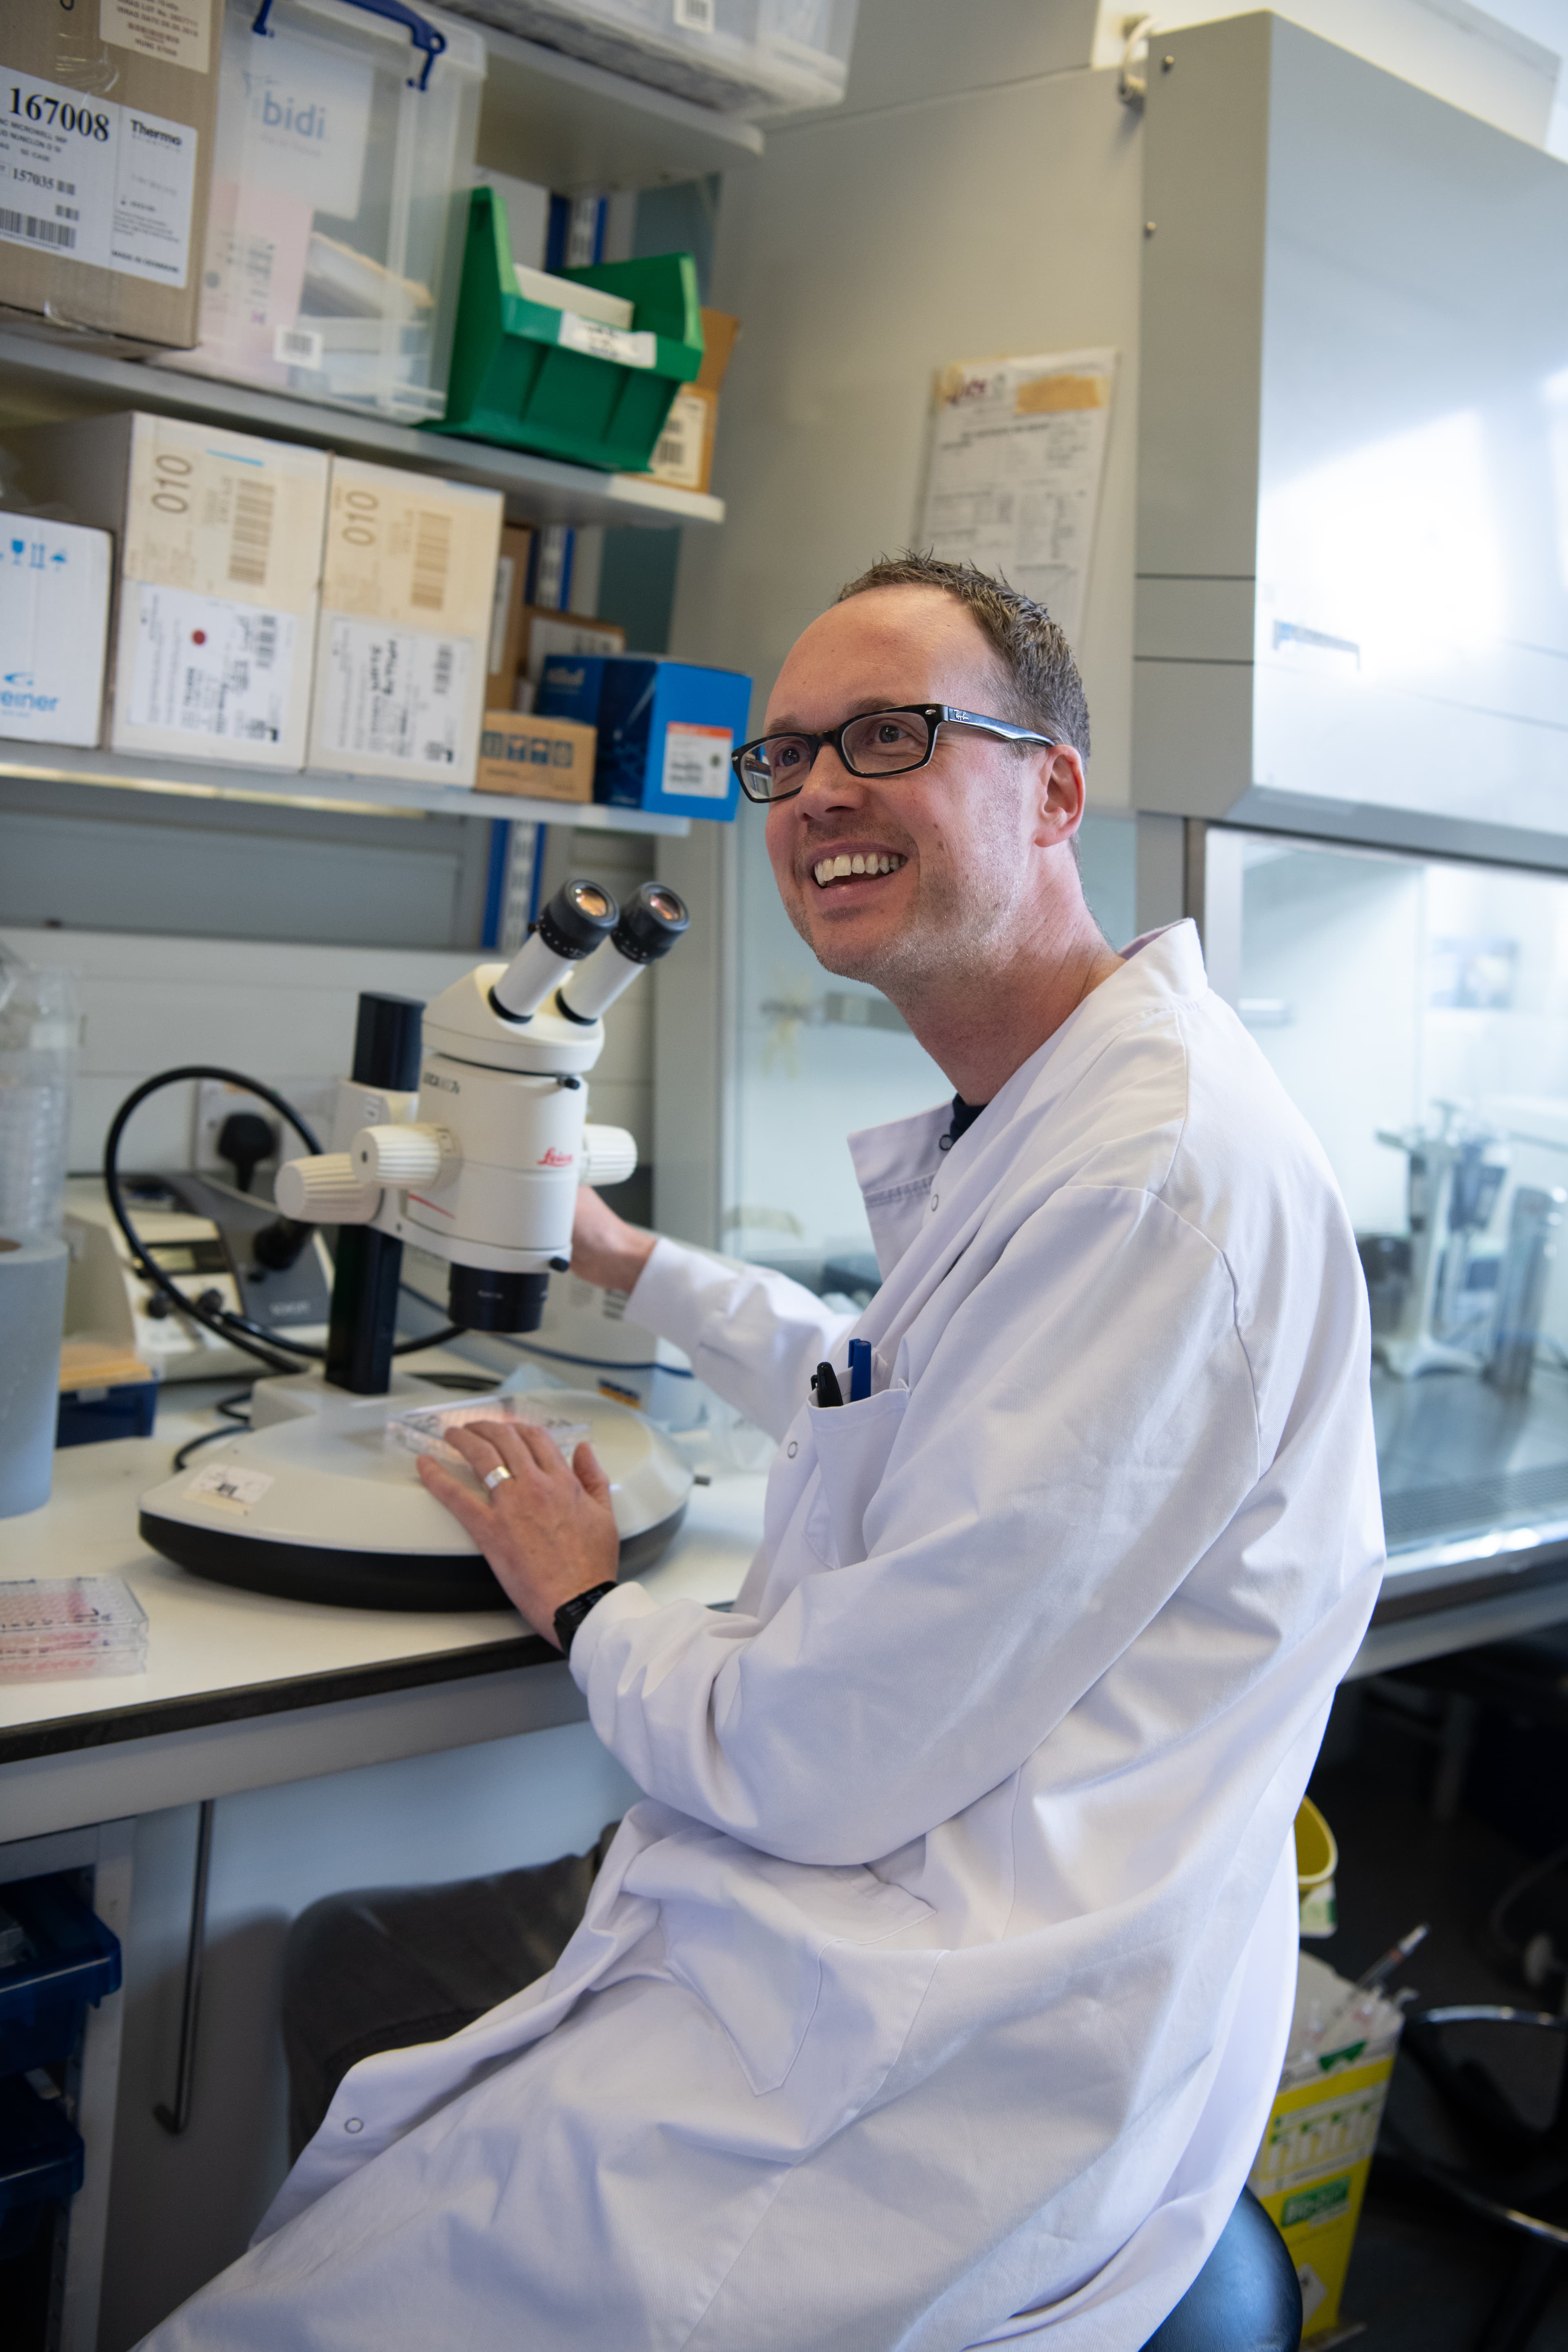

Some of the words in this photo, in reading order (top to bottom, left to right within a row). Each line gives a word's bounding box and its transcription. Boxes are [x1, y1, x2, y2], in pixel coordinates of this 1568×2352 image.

[9, 87, 109, 141] 167008
[130, 118, 183, 146] Thermo
[263, 91, 326, 139] bidi
[13, 167, 54, 190] 157035
[151, 454, 192, 514] 010
[341, 491, 379, 546] 010
[537, 1146, 573, 1167] Leica
